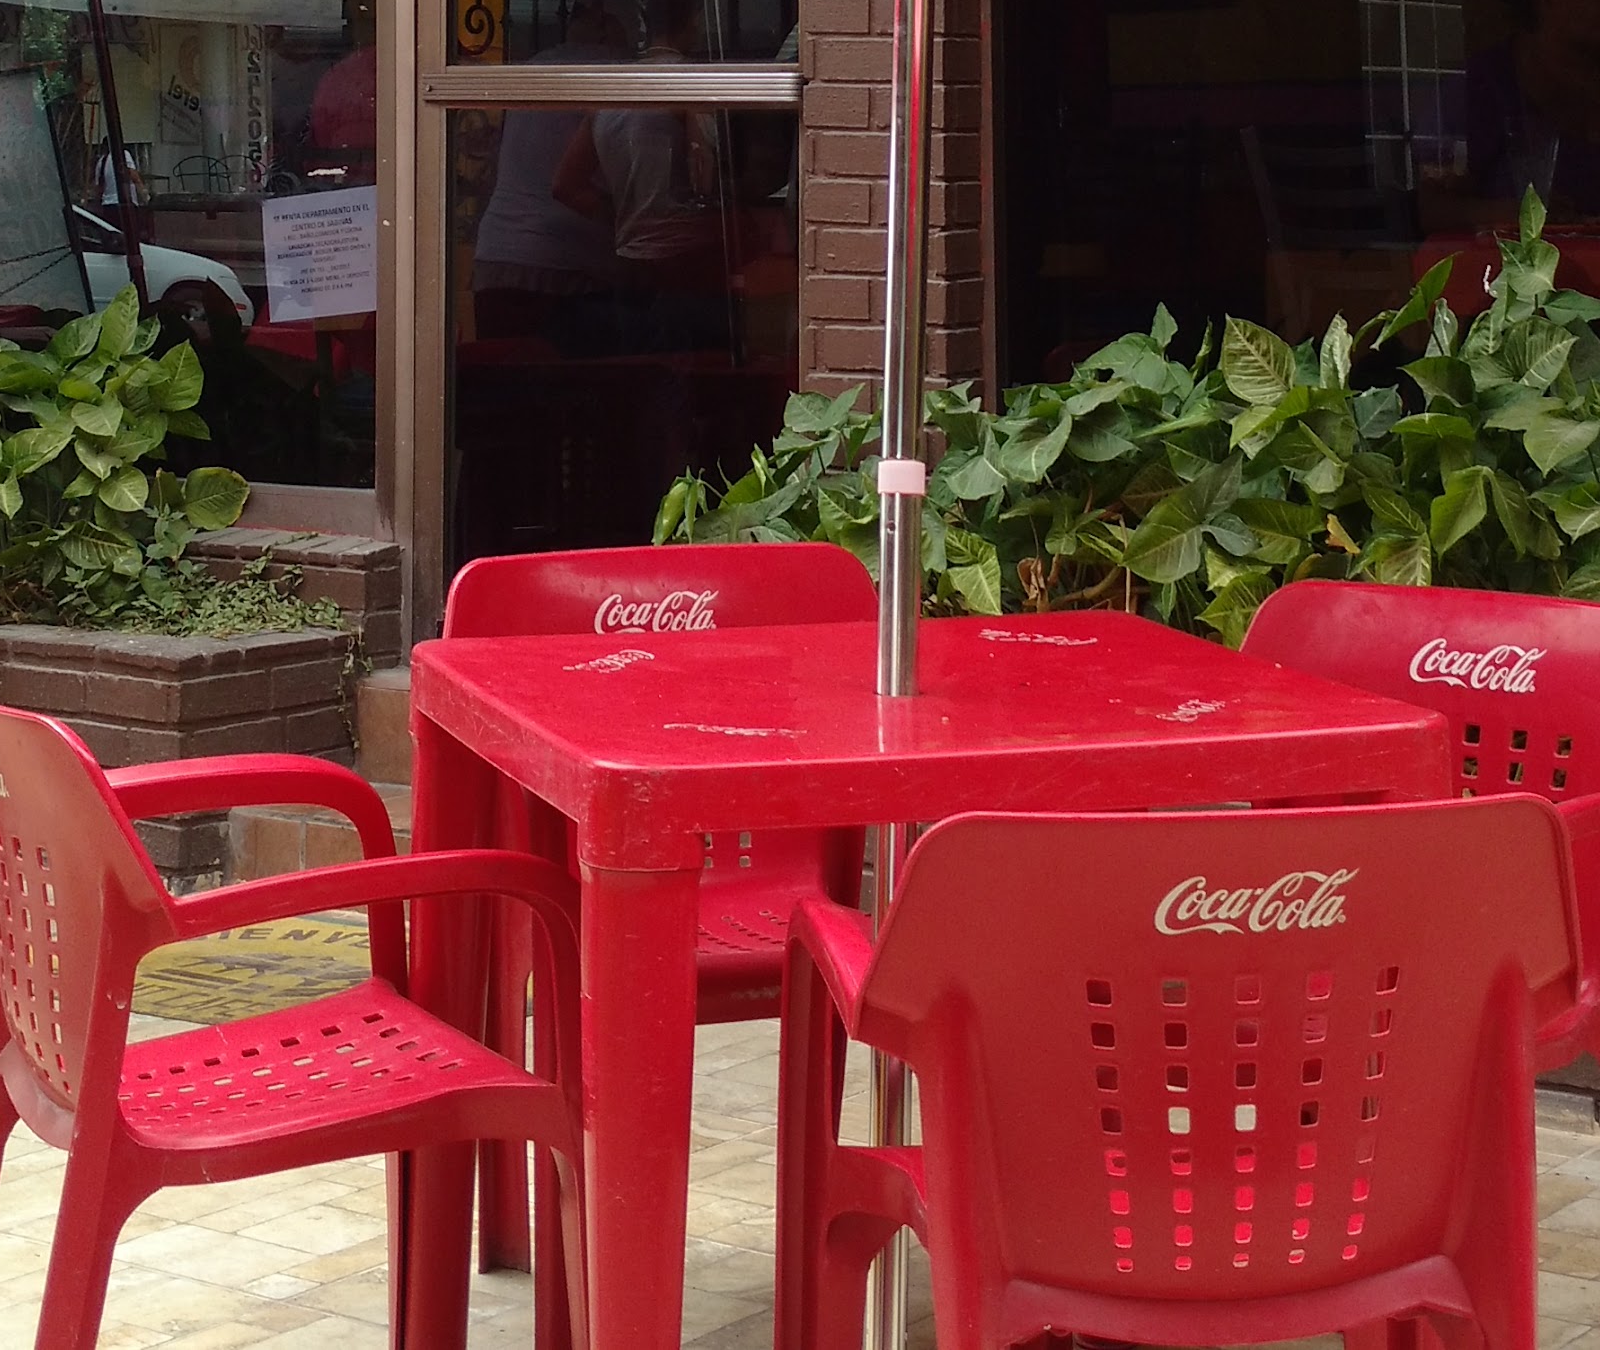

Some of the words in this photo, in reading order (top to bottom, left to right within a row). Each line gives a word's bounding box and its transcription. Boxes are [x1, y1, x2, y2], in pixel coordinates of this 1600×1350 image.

[291, 222, 316, 232] CENTRO
[302, 206, 352, 220] DEPARTAMENTO
[594, 590, 719, 635] Coca-Cola
[1407, 636, 1538, 695] Coca-Cola
[1154, 866, 1359, 936] Coca-Cola
